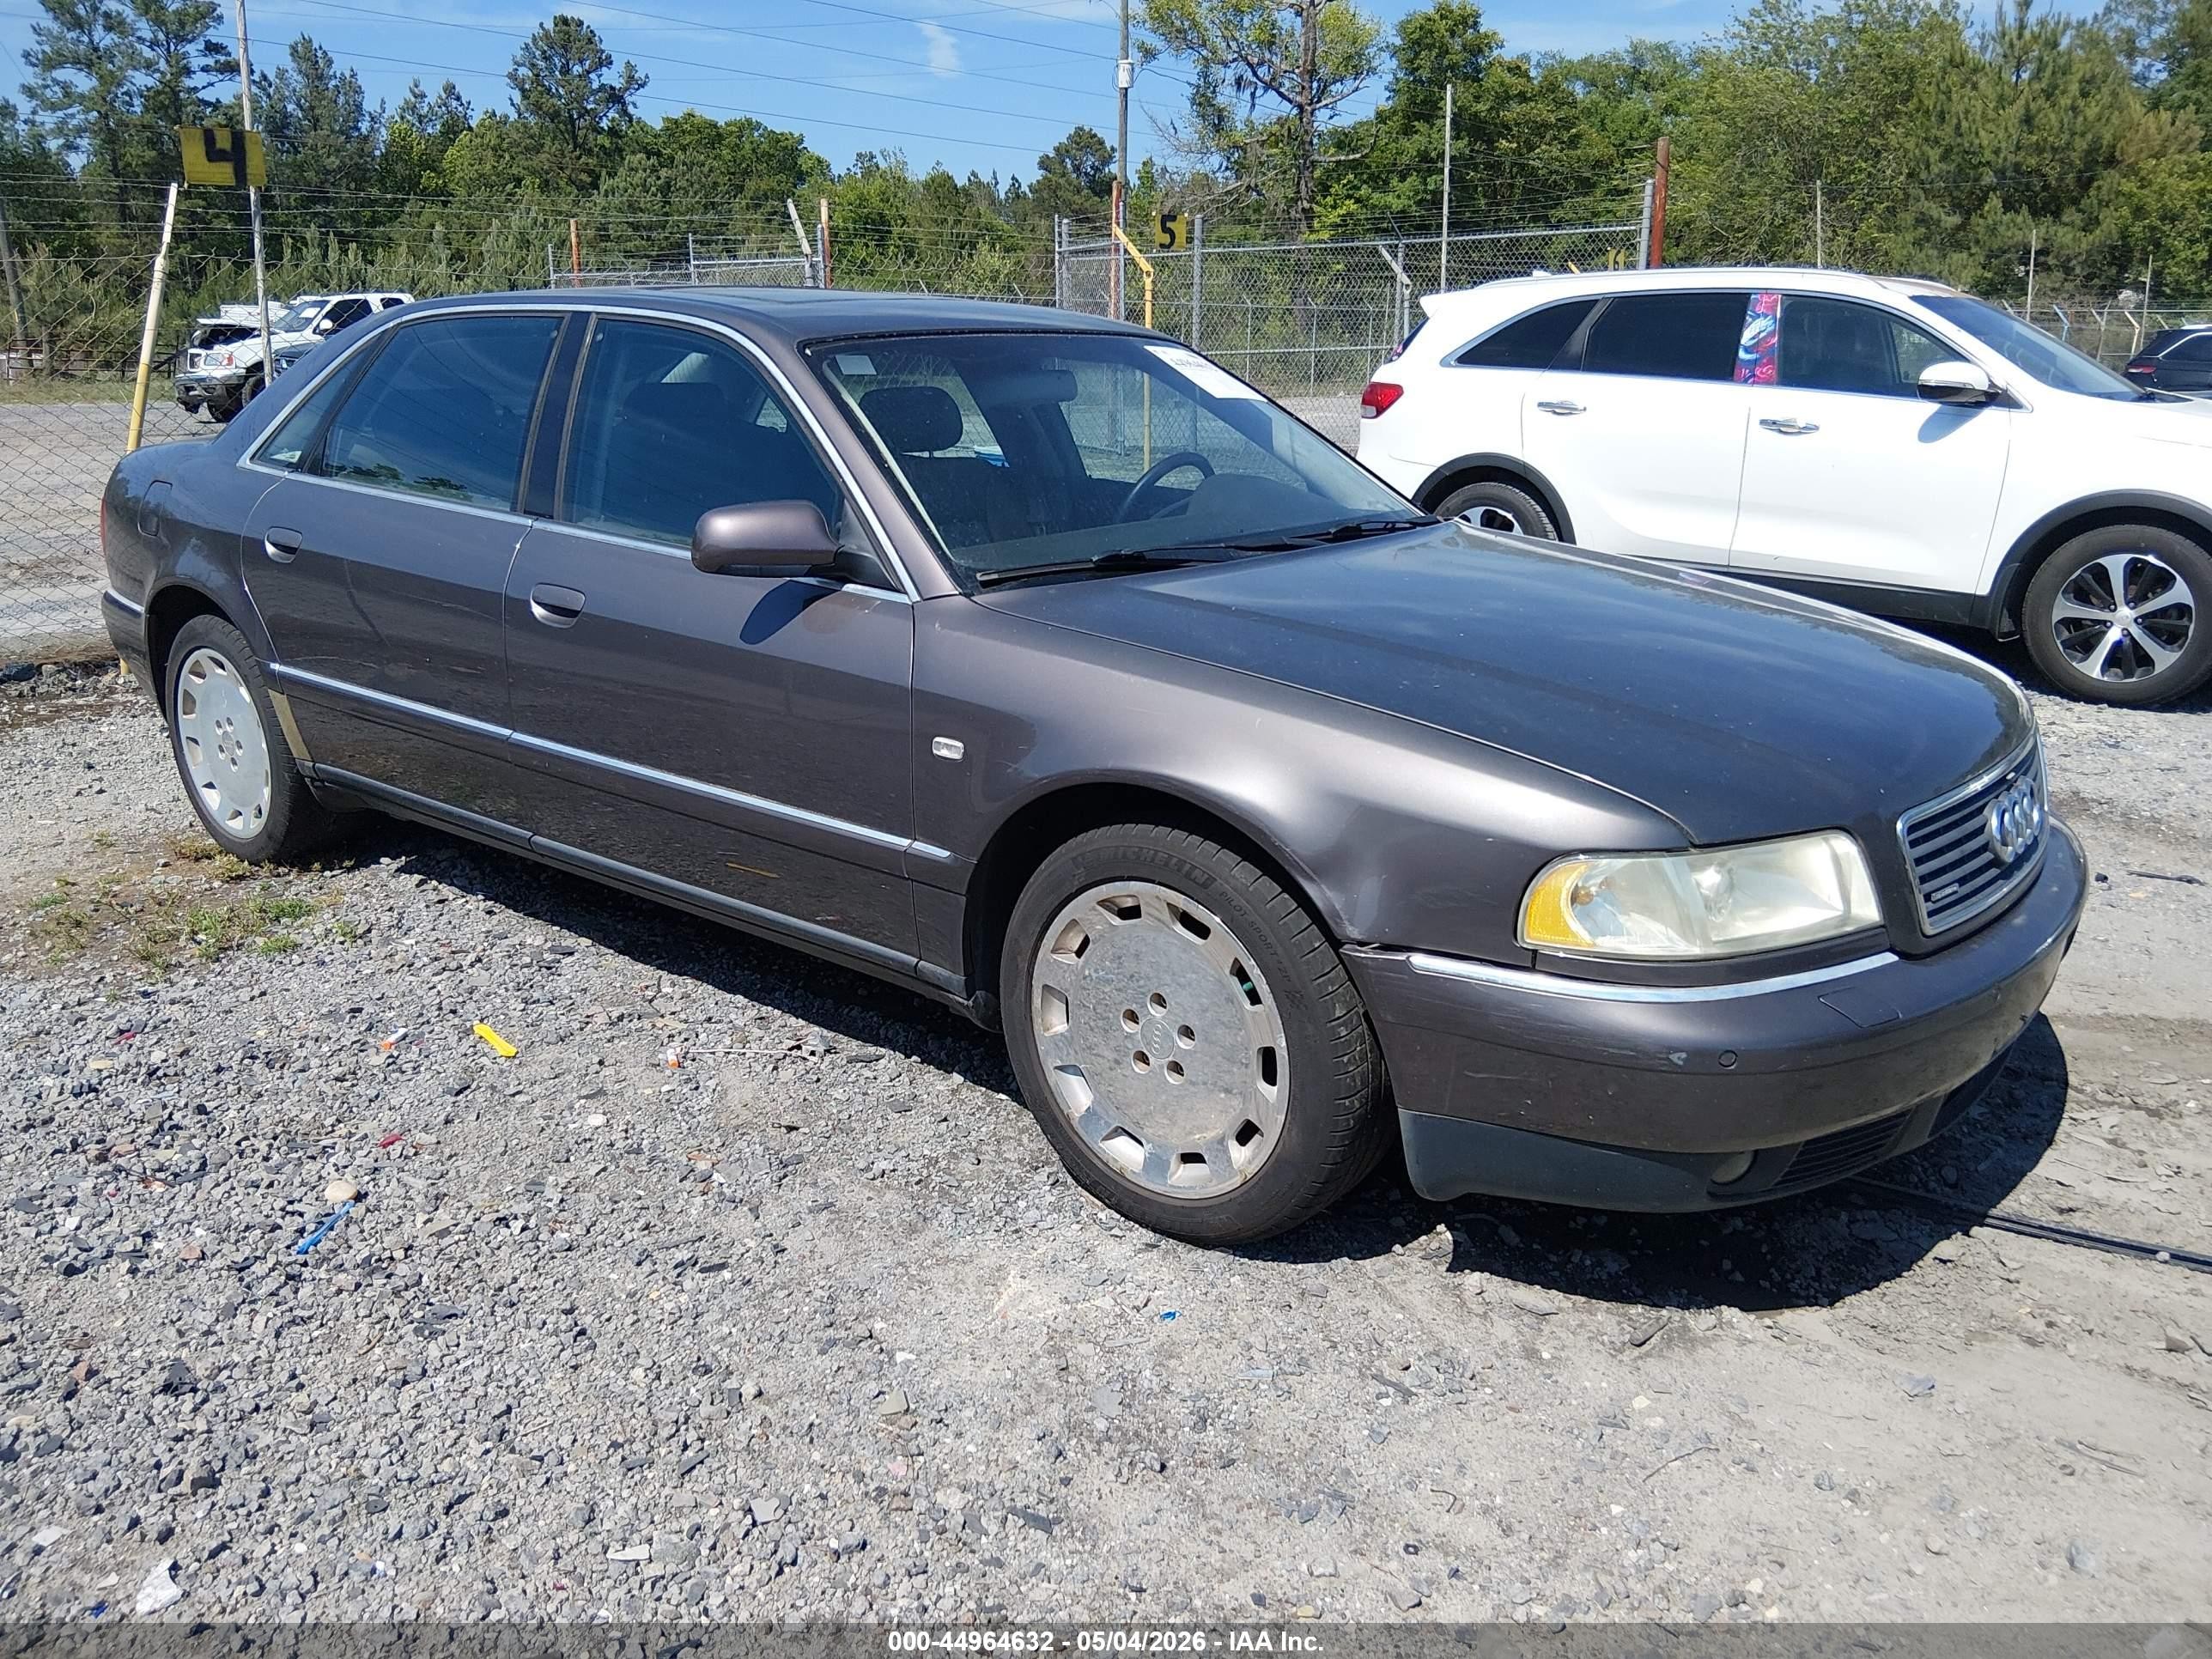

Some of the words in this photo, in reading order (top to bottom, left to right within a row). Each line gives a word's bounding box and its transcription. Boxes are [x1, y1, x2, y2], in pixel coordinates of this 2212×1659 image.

[203, 128, 246, 187] 4
[1159, 214, 1177, 249] 5
[1097, 845, 1213, 890] MICHELIN
[1219, 890, 1249, 917] PILOT
[1249, 921, 1278, 957] SPORT
